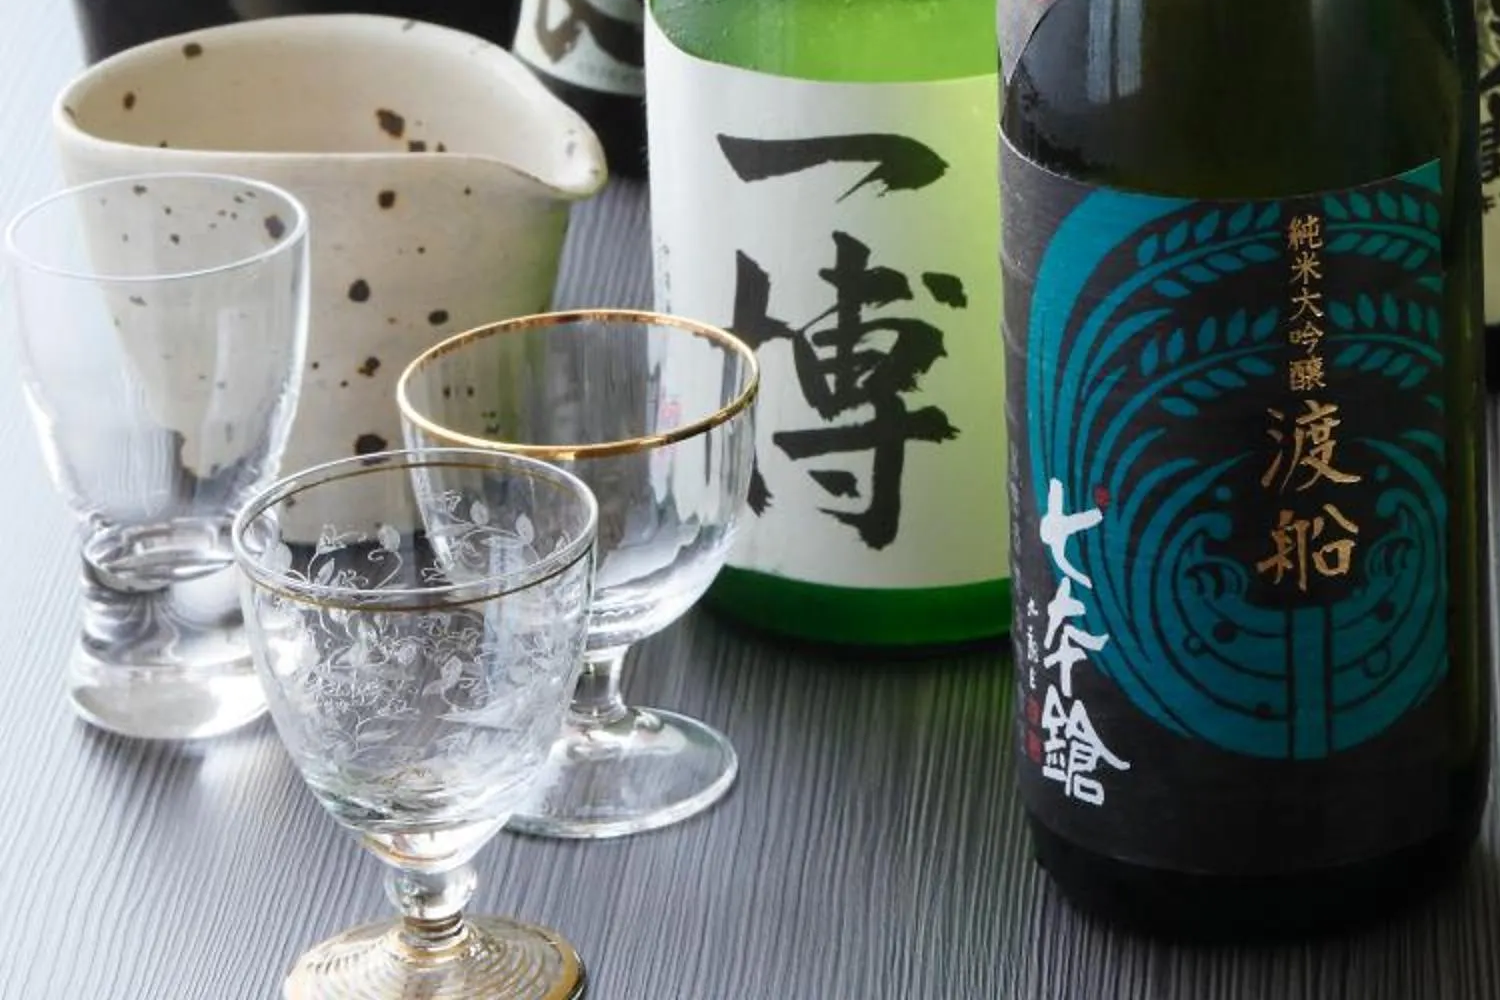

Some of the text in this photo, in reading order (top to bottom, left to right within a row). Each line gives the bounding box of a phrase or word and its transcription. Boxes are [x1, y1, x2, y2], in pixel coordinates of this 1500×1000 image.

[693, 132, 968, 552] 一博
[1286, 214, 1328, 393] 純米大吟醸
[1255, 398, 1363, 593] 渡船
